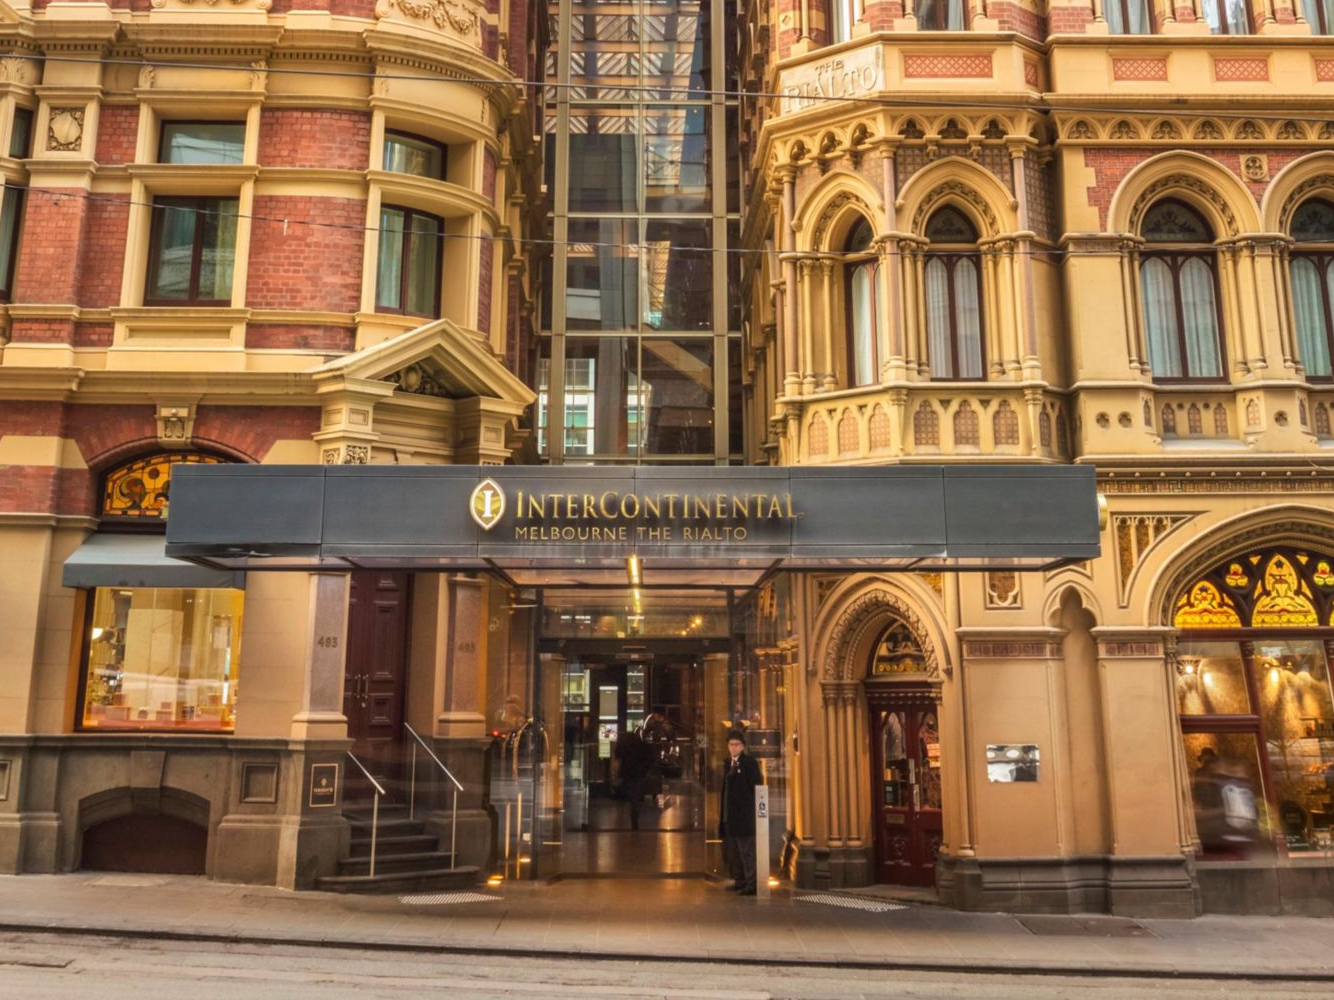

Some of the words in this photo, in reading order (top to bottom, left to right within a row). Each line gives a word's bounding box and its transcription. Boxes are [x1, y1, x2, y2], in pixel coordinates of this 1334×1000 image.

[814, 59, 844, 74] THE
[783, 64, 877, 113] RIALTO
[515, 526, 627, 541] MELBOURNE
[636, 526, 672, 541] THE
[683, 526, 748, 541] RIALTO
[318, 635, 338, 648] 493
